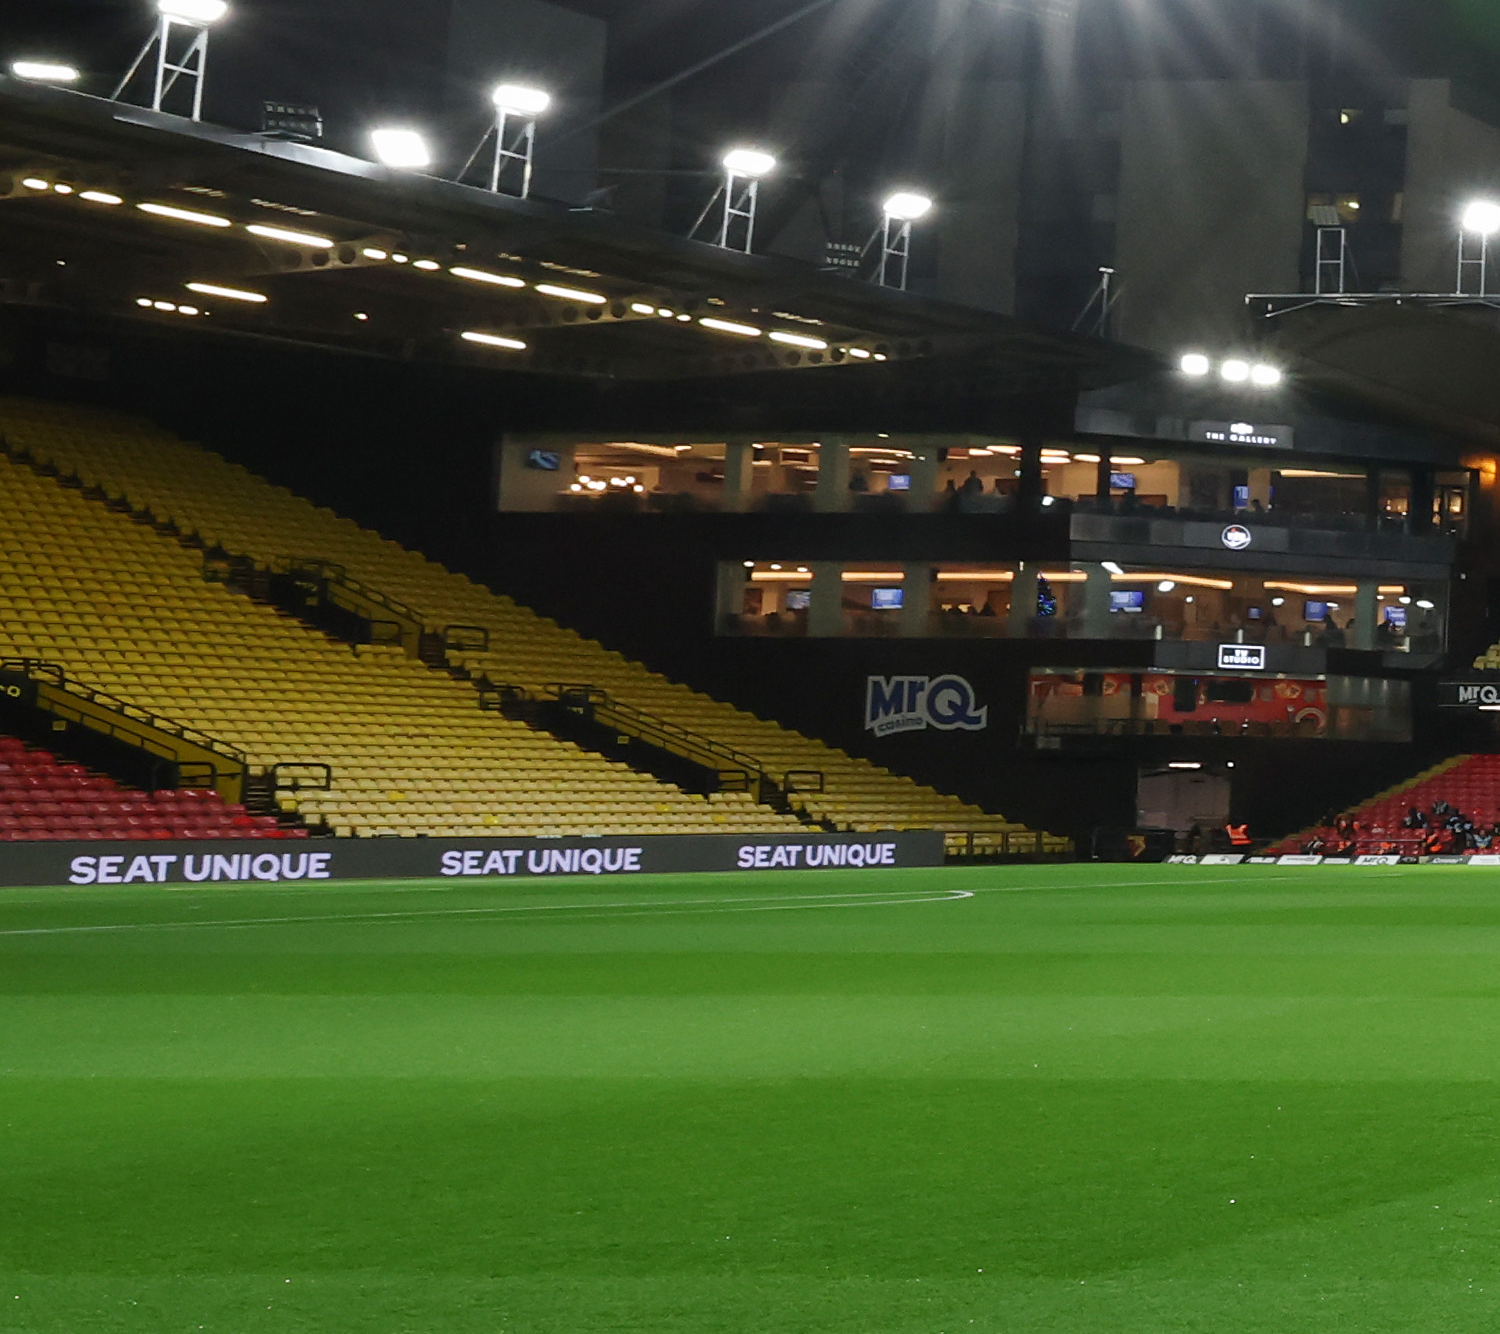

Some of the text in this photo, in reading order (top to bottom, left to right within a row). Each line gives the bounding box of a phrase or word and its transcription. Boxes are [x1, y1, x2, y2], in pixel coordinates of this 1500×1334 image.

[1229, 434, 1277, 444] GALLERY
[1223, 655, 1260, 664] STUDIO
[441, 848, 642, 875] SEAT UNIQUE
[737, 843, 896, 867] SEAT UNIQUE
[69, 853, 332, 884] SEAT UNIQUE
